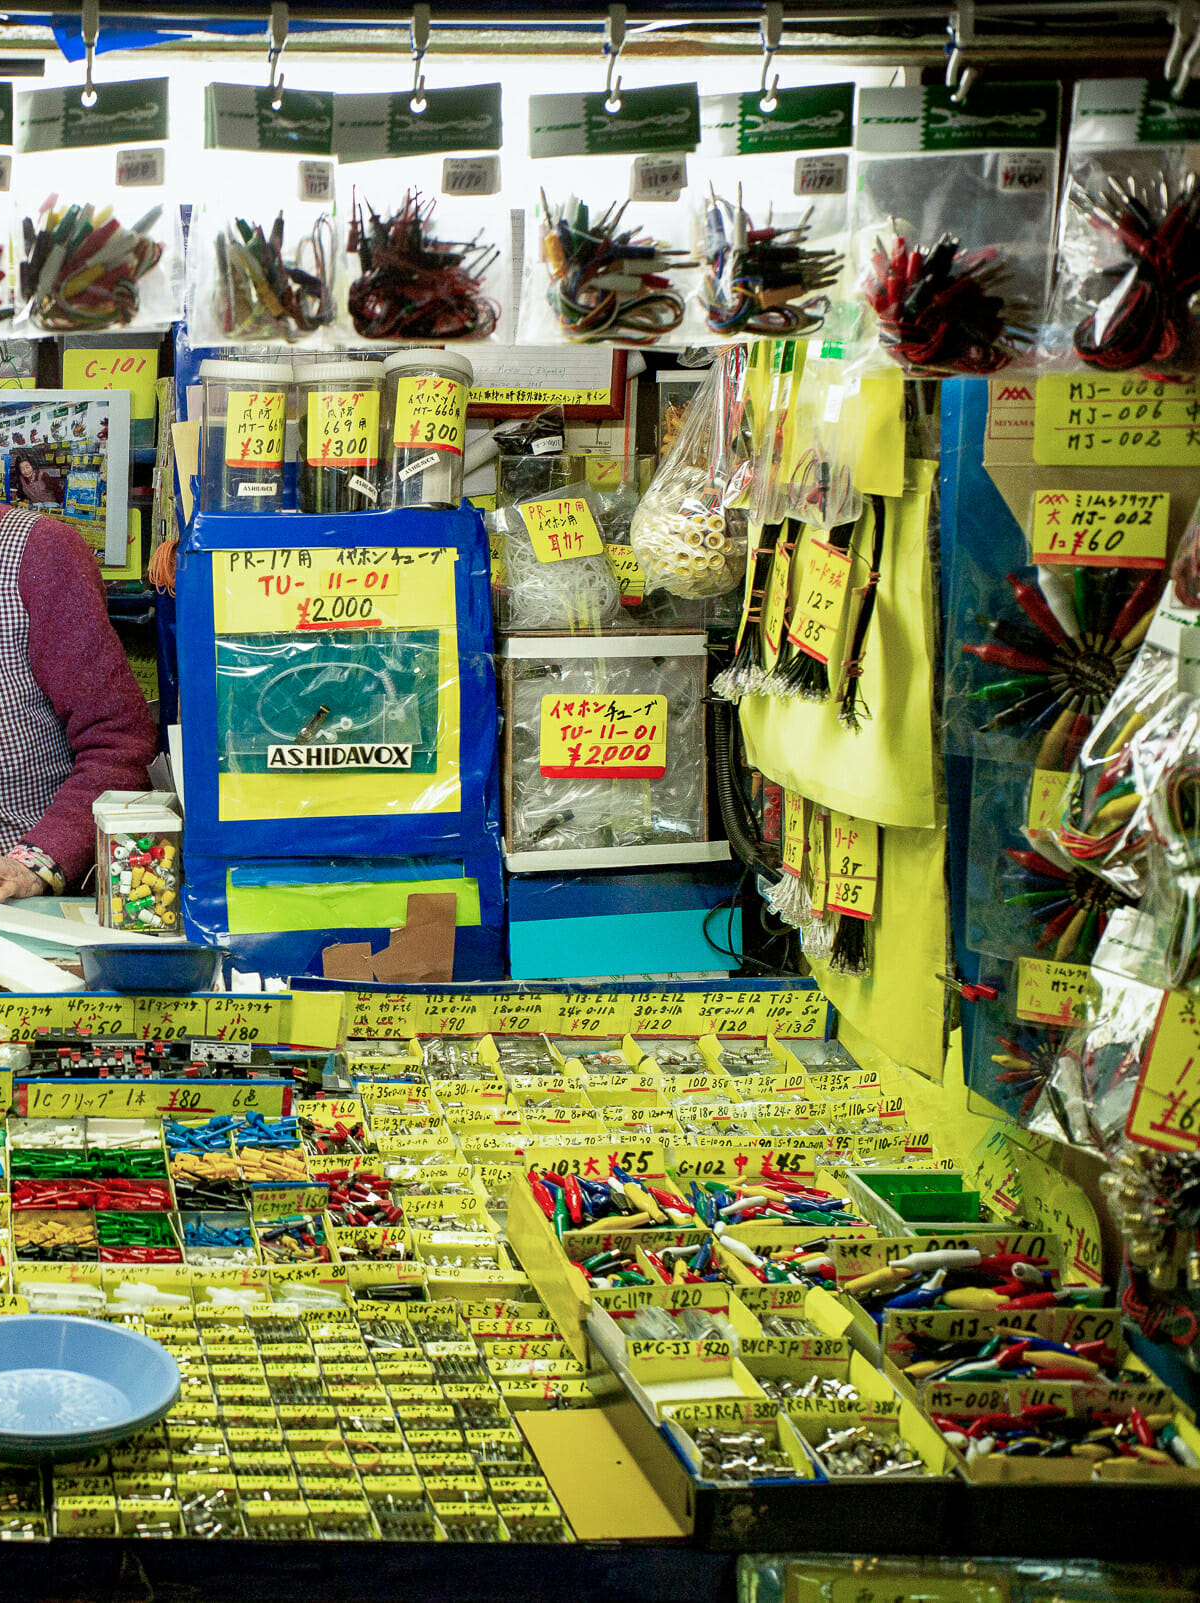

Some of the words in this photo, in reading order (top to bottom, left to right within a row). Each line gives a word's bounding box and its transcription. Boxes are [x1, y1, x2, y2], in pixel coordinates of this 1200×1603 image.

[415, 379, 458, 394] アシダ
[322, 393, 365, 409] アシダ
[1068, 401, 1163, 424] MJ-006
[409, 420, 458, 443] ¥300
[1068, 431, 1162, 450] MJ-002
[241, 437, 281, 459] ¥300
[321, 437, 367, 458] ¥300
[1047, 509, 1060, 525] 大
[1072, 511, 1153, 525] MJ-002
[548, 532, 584, 557] 耳カケ
[1071, 529, 1124, 556] ¥60
[795, 615, 826, 642] ¥85
[549, 700, 659, 720] イヤホンチューブ
[560, 723, 658, 742] TU-11-01
[268, 746, 410, 767] ASHIDAVOX
[833, 881, 864, 906] ¥85
[142, 1024, 188, 1042] ¥200
[217, 1025, 260, 1042] ¥180
[440, 1017, 465, 1032] ¥90
[500, 1017, 530, 1032] ¥90
[571, 1019, 601, 1032] ¥90
[637, 1019, 672, 1032] ¥120
[710, 1019, 748, 1032] ¥120
[774, 1020, 814, 1035] ¥130
[689, 1078, 707, 1088] 100
[784, 1076, 803, 1087] 100
[858, 1072, 877, 1084] 100
[169, 1087, 203, 1110] ¥80
[331, 1102, 355, 1117] ¥60
[904, 1134, 929, 1147] ¥110
[584, 1158, 600, 1175] 大
[608, 1151, 654, 1173] ¥55
[678, 1160, 726, 1175] C-102
[733, 1153, 748, 1176] 中
[761, 1151, 802, 1173] ¥45
[296, 1192, 327, 1210] ¥150
[382, 1229, 405, 1243] ¥60
[602, 1234, 632, 1250] ¥90
[1074, 1229, 1100, 1264] ¥60
[331, 1266, 346, 1277] 80
[661, 1289, 702, 1308] ¥420
[770, 1288, 800, 1306] ¥380
[478, 1321, 499, 1331] E-5
[1063, 1315, 1114, 1340] ¥50
[492, 1345, 514, 1356] E-5
[520, 1344, 547, 1358] ¥45
[632, 1342, 690, 1356] BNC-JJ
[696, 1342, 729, 1356] ¥420
[801, 1339, 843, 1357] ¥380
[867, 1401, 895, 1416] ¥380
[931, 1392, 999, 1409] MJ-008
[744, 1403, 778, 1422] ¥380
